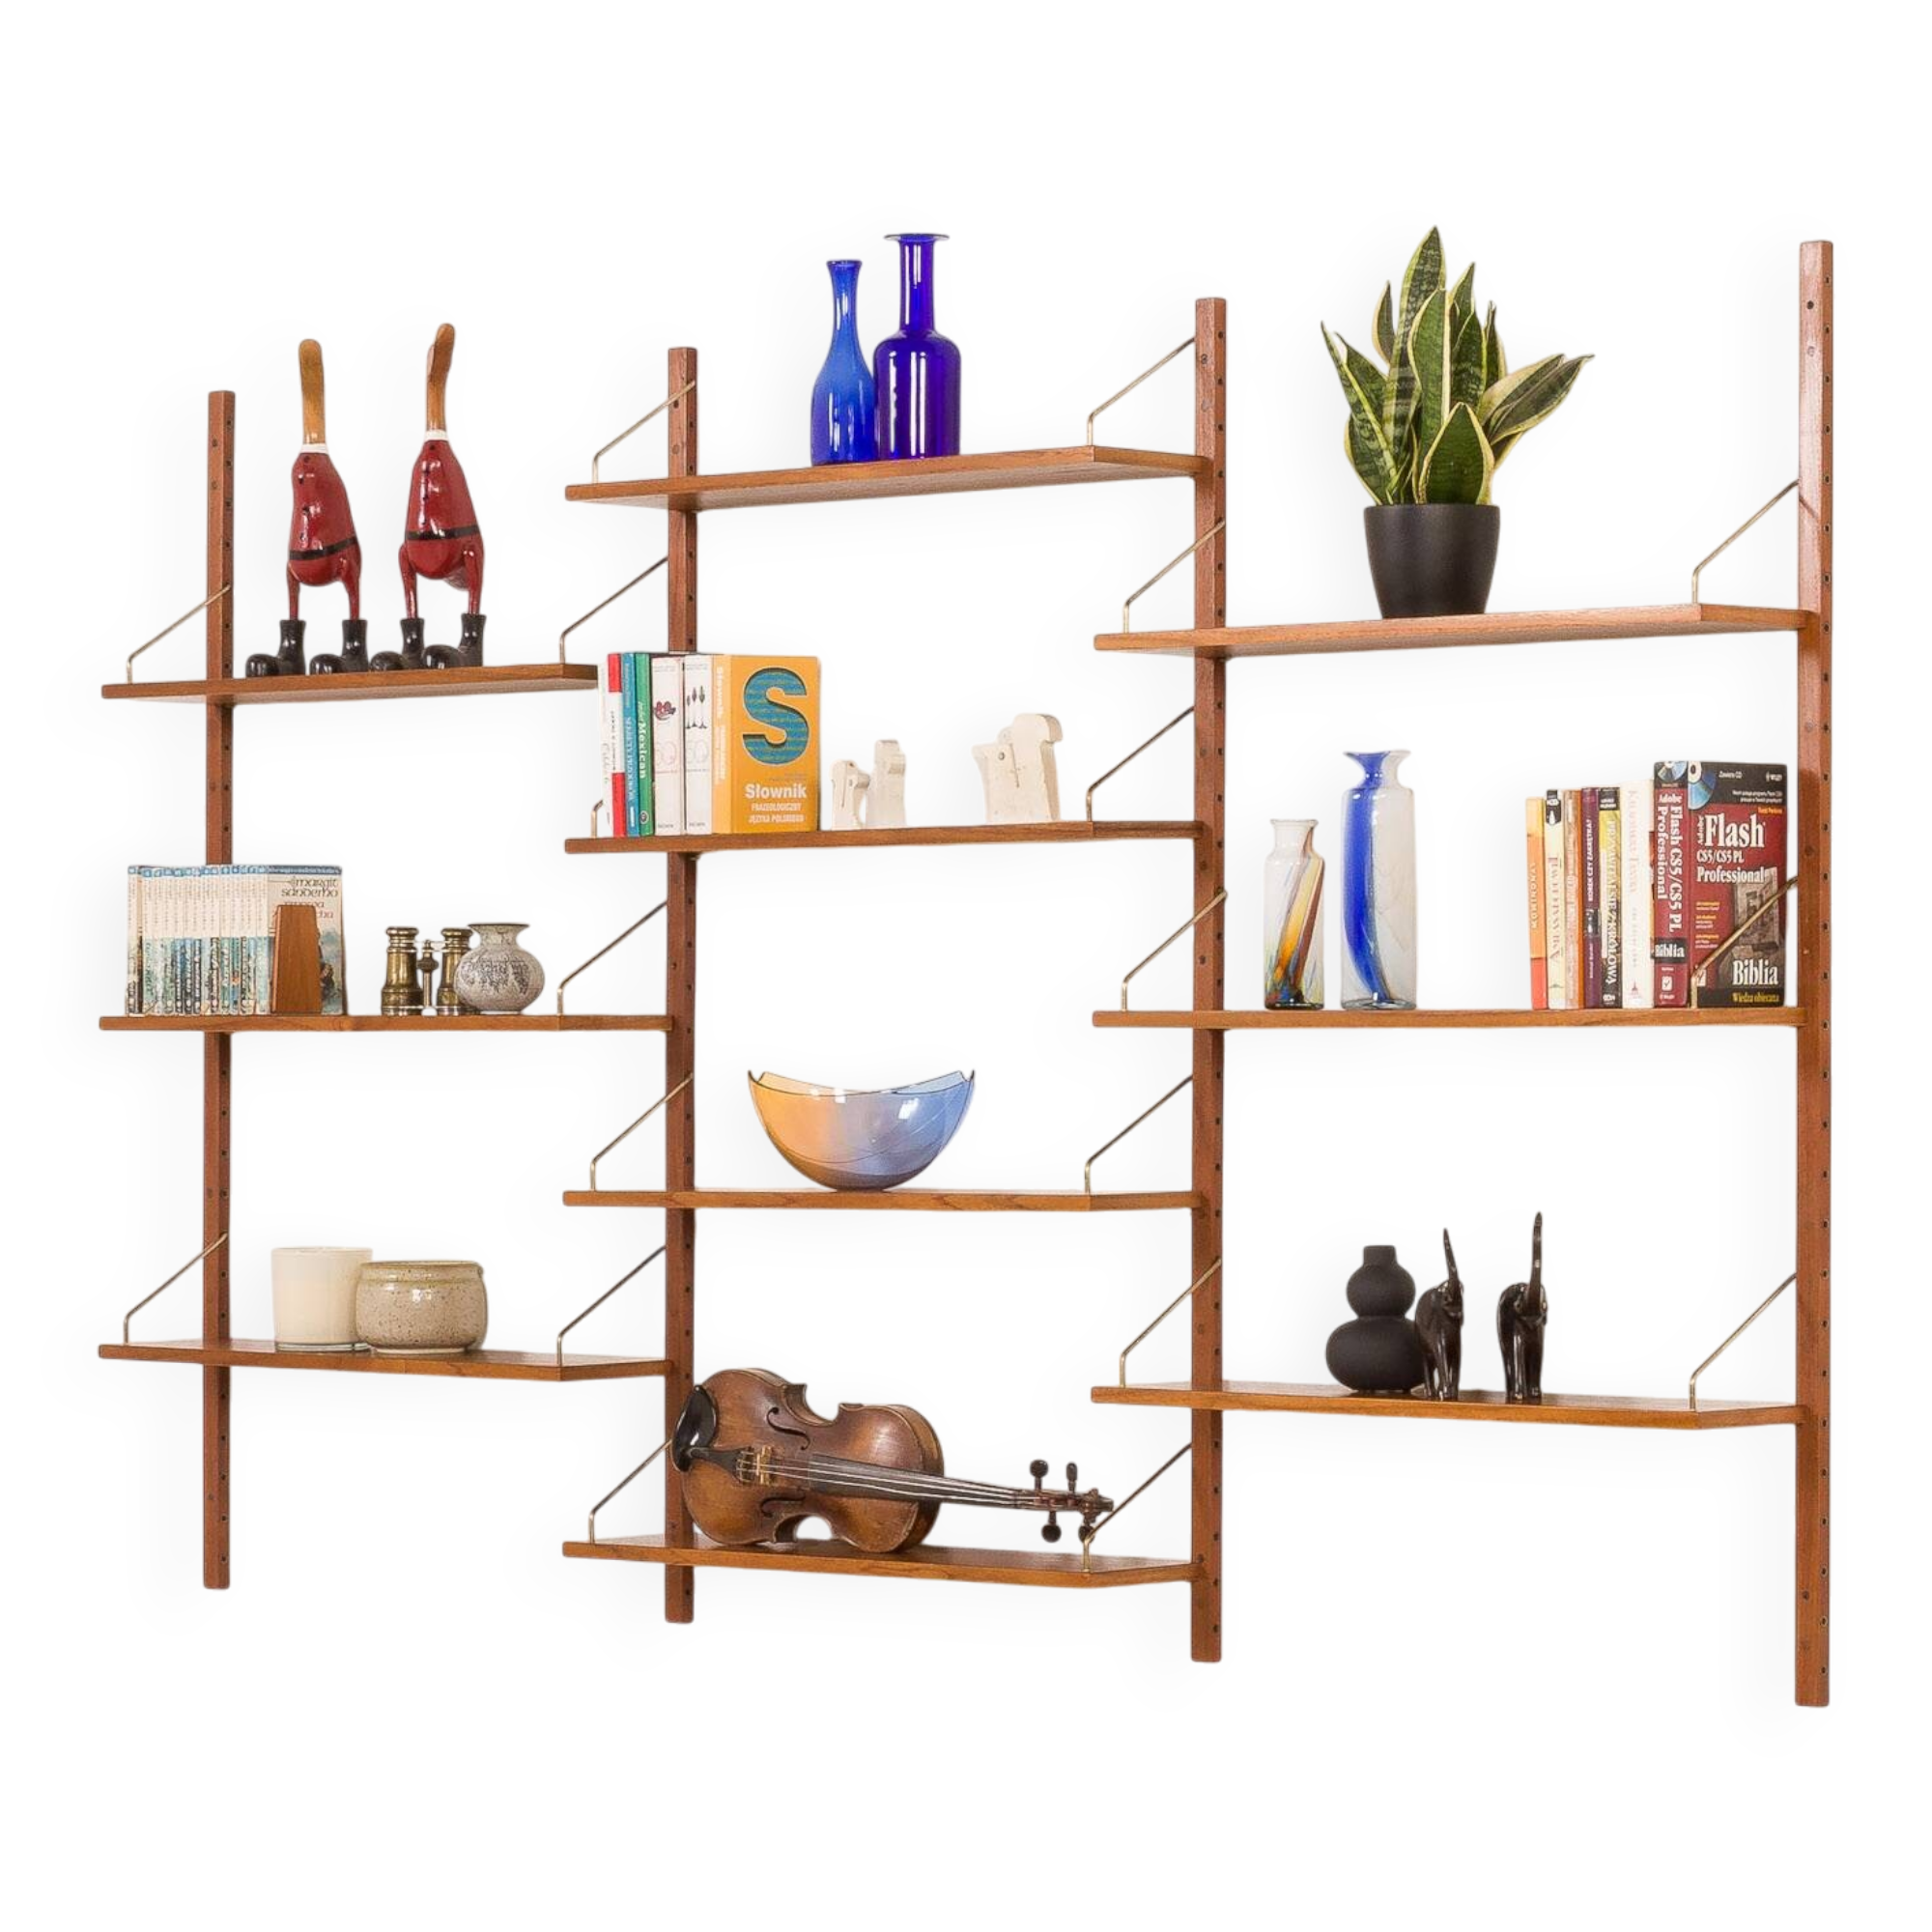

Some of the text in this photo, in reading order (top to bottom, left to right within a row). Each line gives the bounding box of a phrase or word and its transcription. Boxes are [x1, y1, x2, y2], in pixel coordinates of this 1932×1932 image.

[742, 666, 810, 766] S
[639, 721, 648, 780] Mexican
[744, 782, 808, 800] Słownik
[1704, 812, 1766, 848] Flash
[1657, 806, 1668, 899] Professional
[1668, 806, 1684, 933] Flash CS5/CS5 PL
[1696, 849, 1746, 865] CS5/CS5 PL
[1696, 865, 1766, 884] Professional
[1605, 922, 1619, 985] KRÓLOWĄ
[1654, 943, 1685, 958] Biblia
[1731, 958, 1778, 985] Biblia
